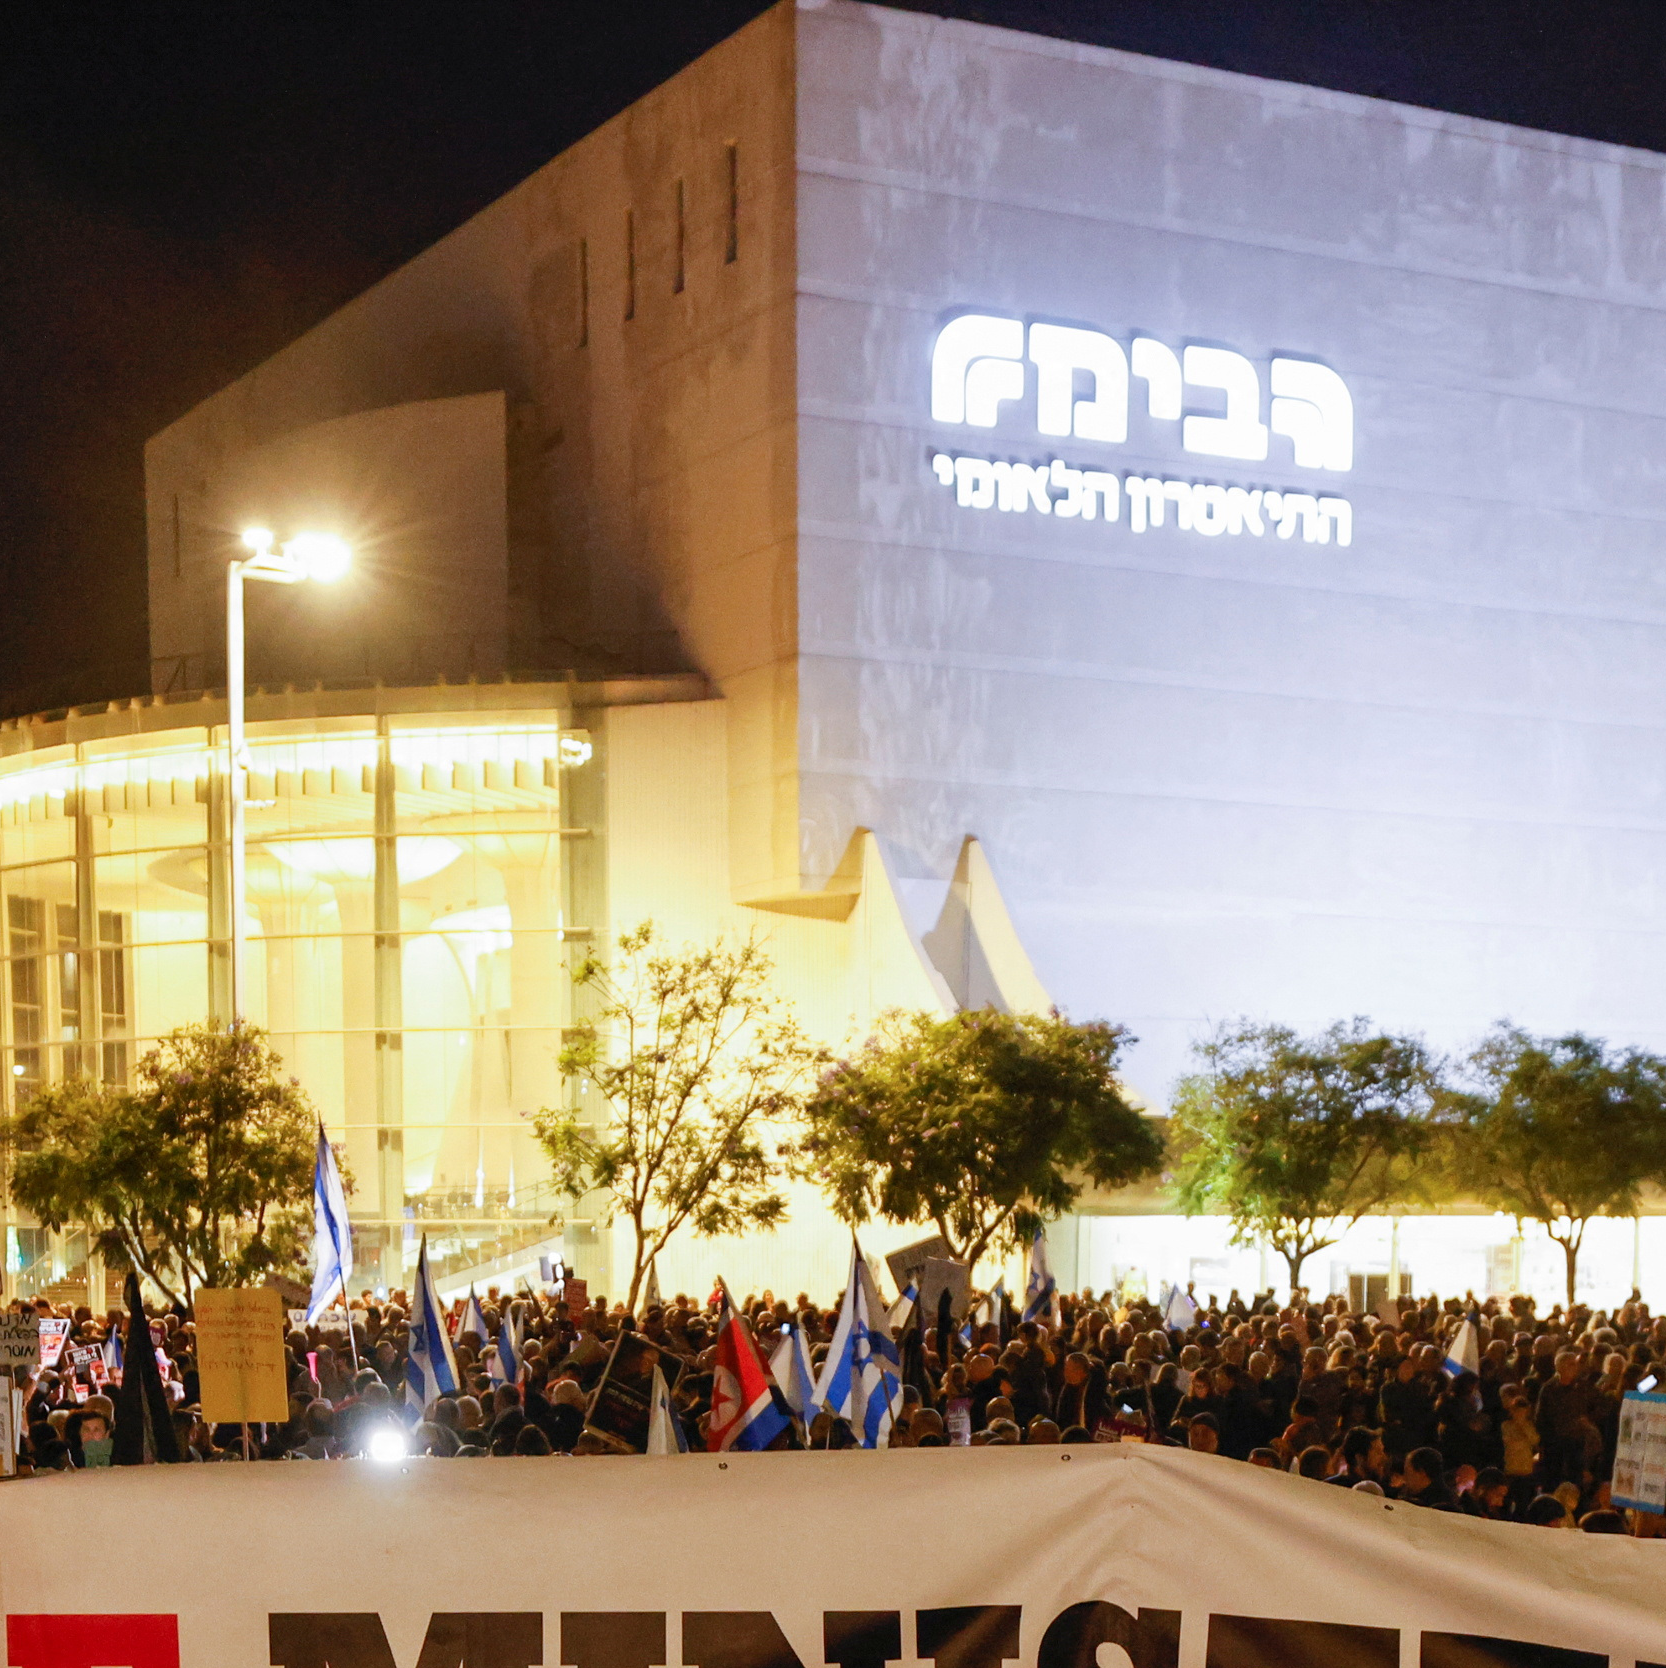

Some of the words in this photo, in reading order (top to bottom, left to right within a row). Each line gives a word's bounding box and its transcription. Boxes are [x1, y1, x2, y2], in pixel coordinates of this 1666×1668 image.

[931, 314, 1353, 472] הבימה
[932, 453, 1121, 522] הלאומי
[1125, 477, 1353, 547] התיאטרון
